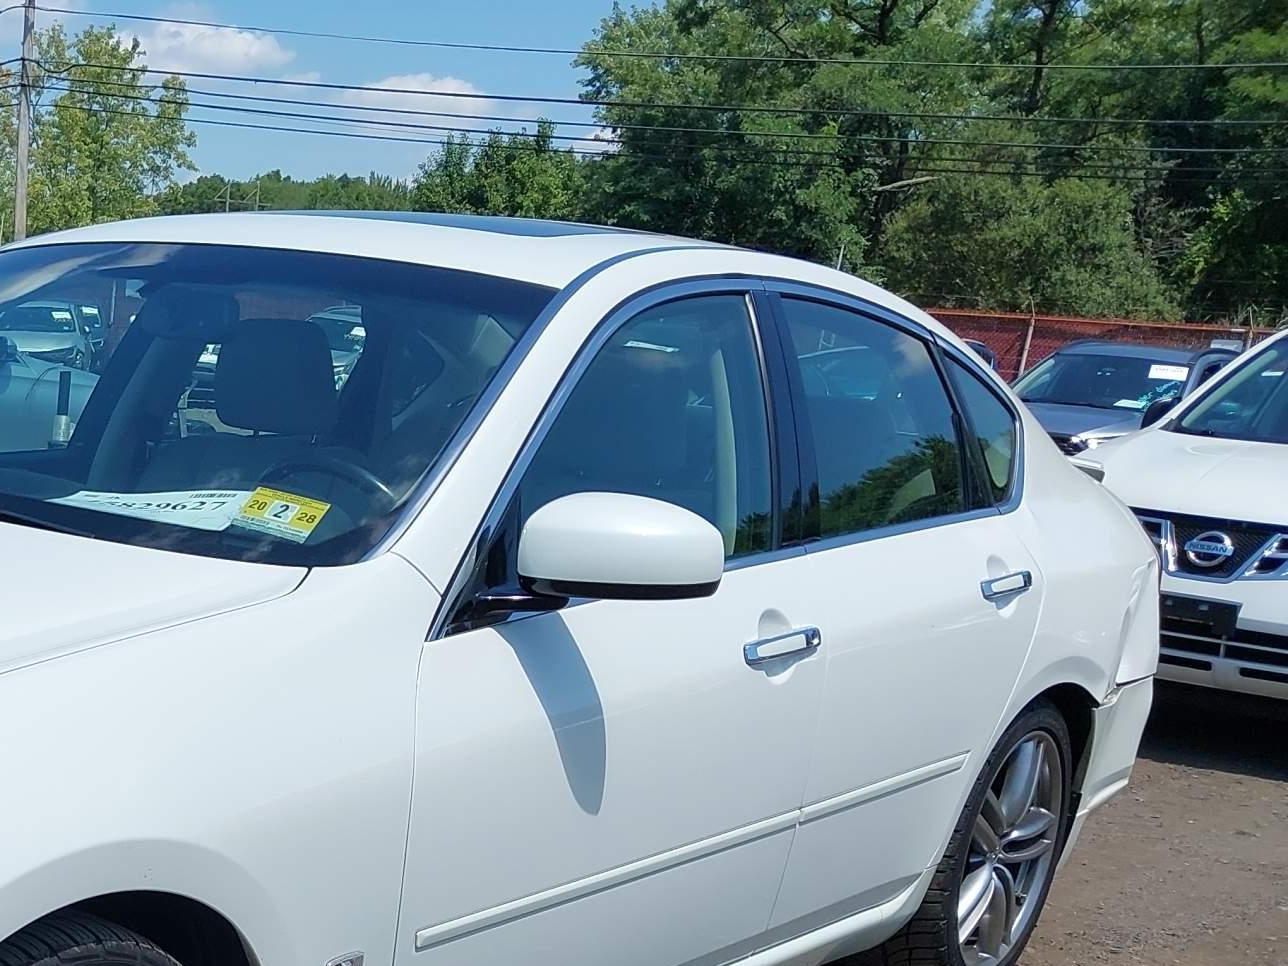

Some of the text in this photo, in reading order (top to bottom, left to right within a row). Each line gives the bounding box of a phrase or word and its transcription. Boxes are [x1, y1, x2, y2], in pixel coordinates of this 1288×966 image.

[248, 499, 268, 511] 20
[272, 503, 290, 519] 2
[296, 512, 317, 524] 28
[1187, 541, 1229, 554] NISSAN
